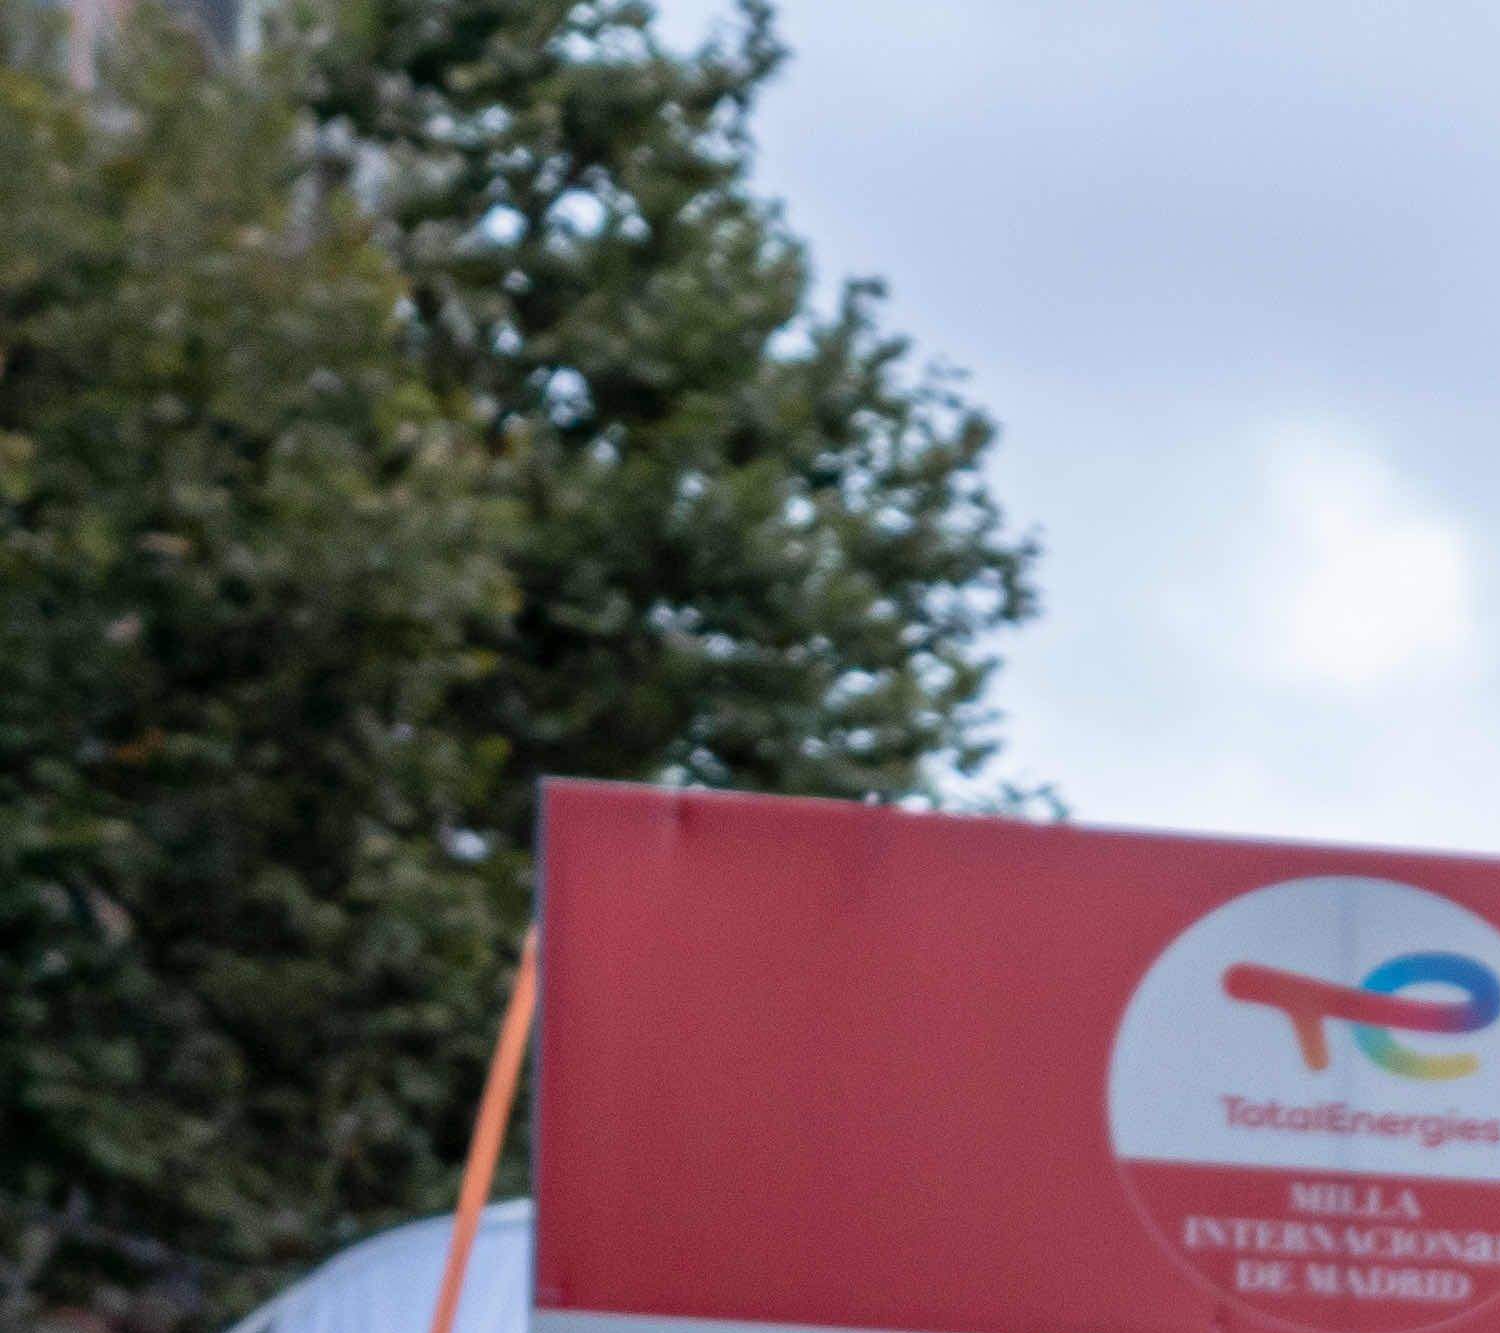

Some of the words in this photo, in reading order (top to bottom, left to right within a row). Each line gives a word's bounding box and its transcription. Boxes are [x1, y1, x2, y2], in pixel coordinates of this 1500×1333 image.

[1291, 1181, 1420, 1215] MILLA
[1237, 1262, 1294, 1295] DE
[1307, 1265, 1470, 1301] MADRID
